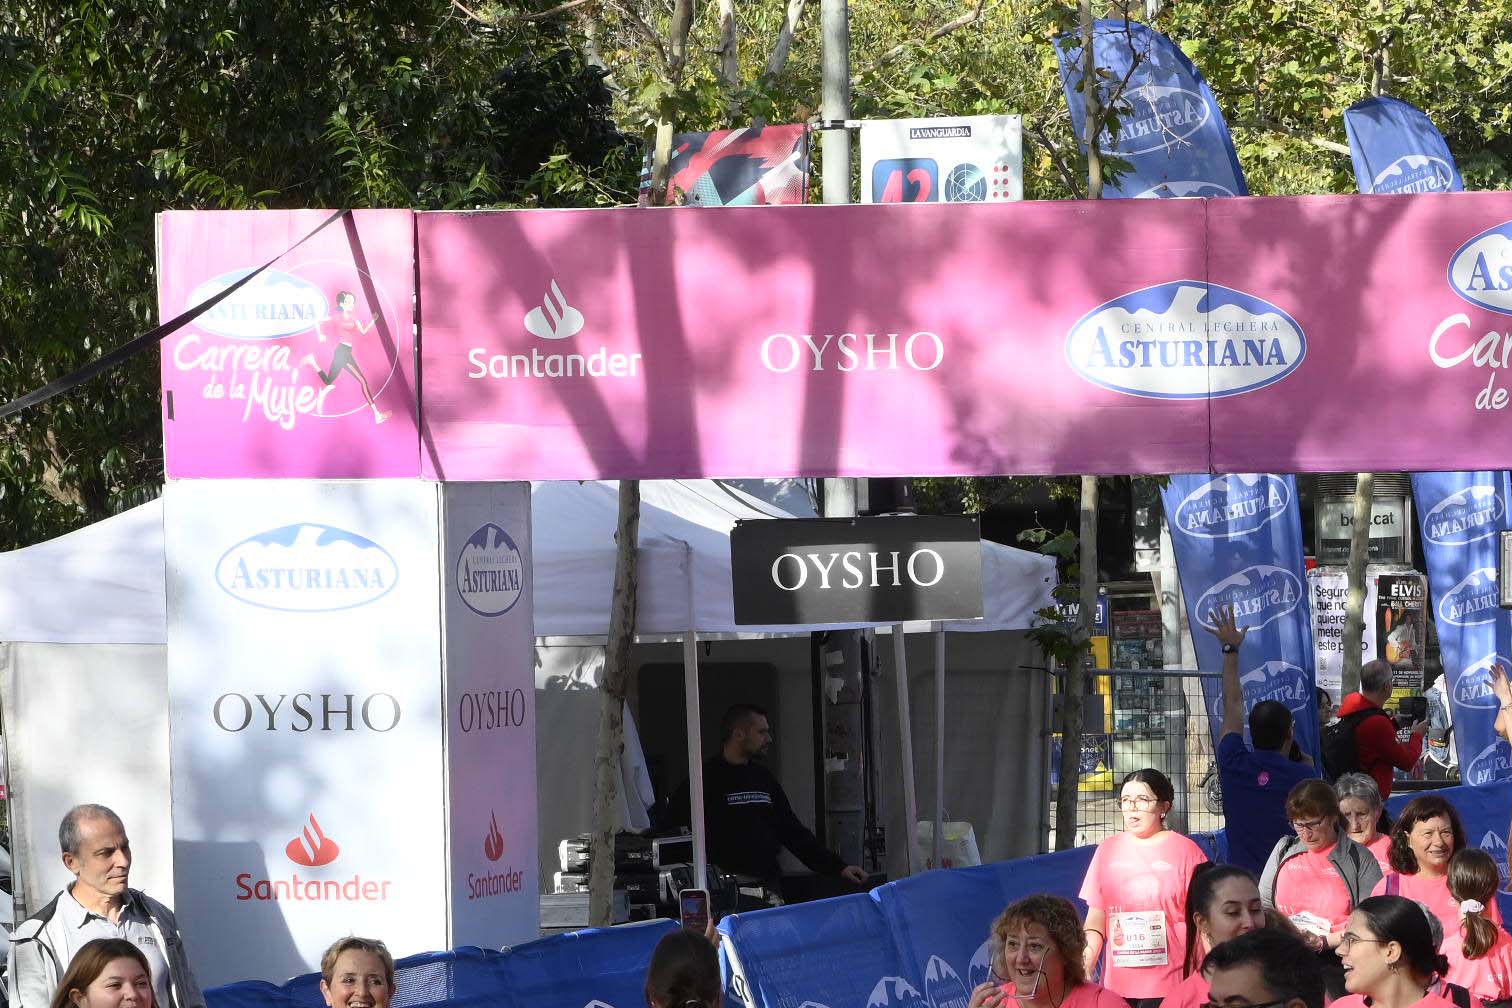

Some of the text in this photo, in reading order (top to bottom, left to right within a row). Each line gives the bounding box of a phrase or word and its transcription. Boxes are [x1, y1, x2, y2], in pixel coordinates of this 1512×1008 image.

[921, 126, 970, 138] VANGUARDIA
[1121, 321, 1280, 333] CENTRAL LECHERA
[174, 334, 291, 376] Carrera
[469, 347, 642, 379] Santander
[761, 331, 944, 372] OYSHO
[1088, 326, 1288, 369] ASTURIANA
[204, 367, 336, 430] de la Mujer
[1475, 372, 1510, 410] de
[231, 557, 385, 590] ASTURIANA
[462, 559, 520, 593] ASTURIANA
[772, 548, 945, 591] OYSHO
[1391, 584, 1422, 597] ELVIS
[213, 692, 402, 732] OYSHO
[459, 688, 526, 733] OYSHO
[236, 874, 391, 901] Santander
[468, 867, 523, 900] Santander
